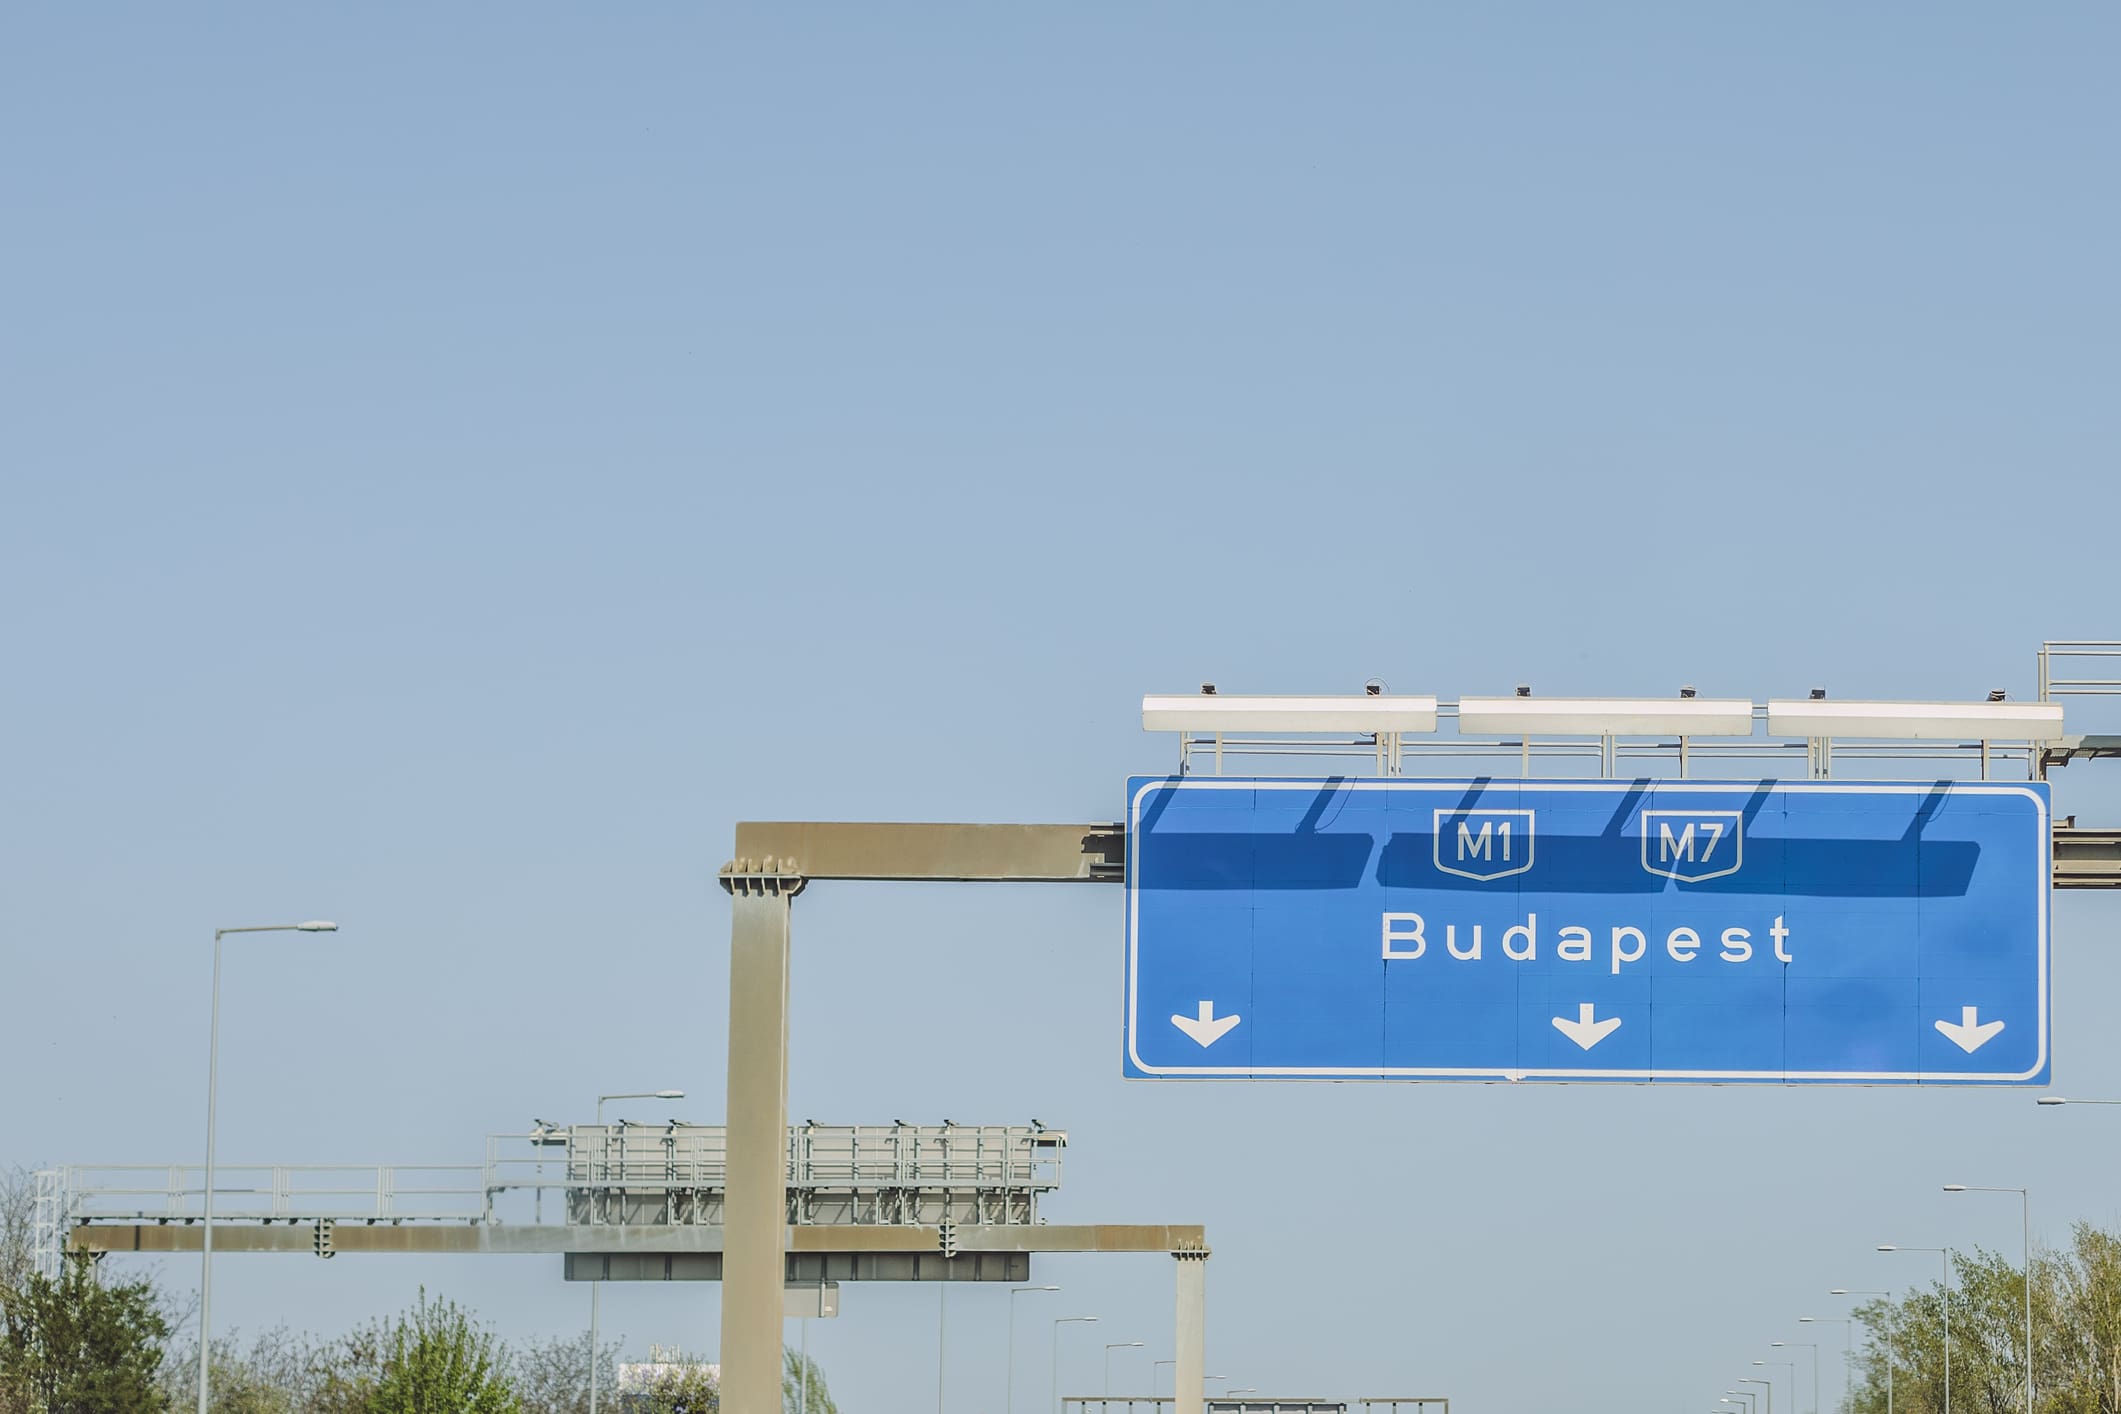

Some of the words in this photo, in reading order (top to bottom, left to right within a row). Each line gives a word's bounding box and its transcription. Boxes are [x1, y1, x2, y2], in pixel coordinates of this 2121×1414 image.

[1456, 821, 1511, 862] M1
[1659, 822, 1724, 863] M7
[1381, 911, 1793, 975] Budapest
